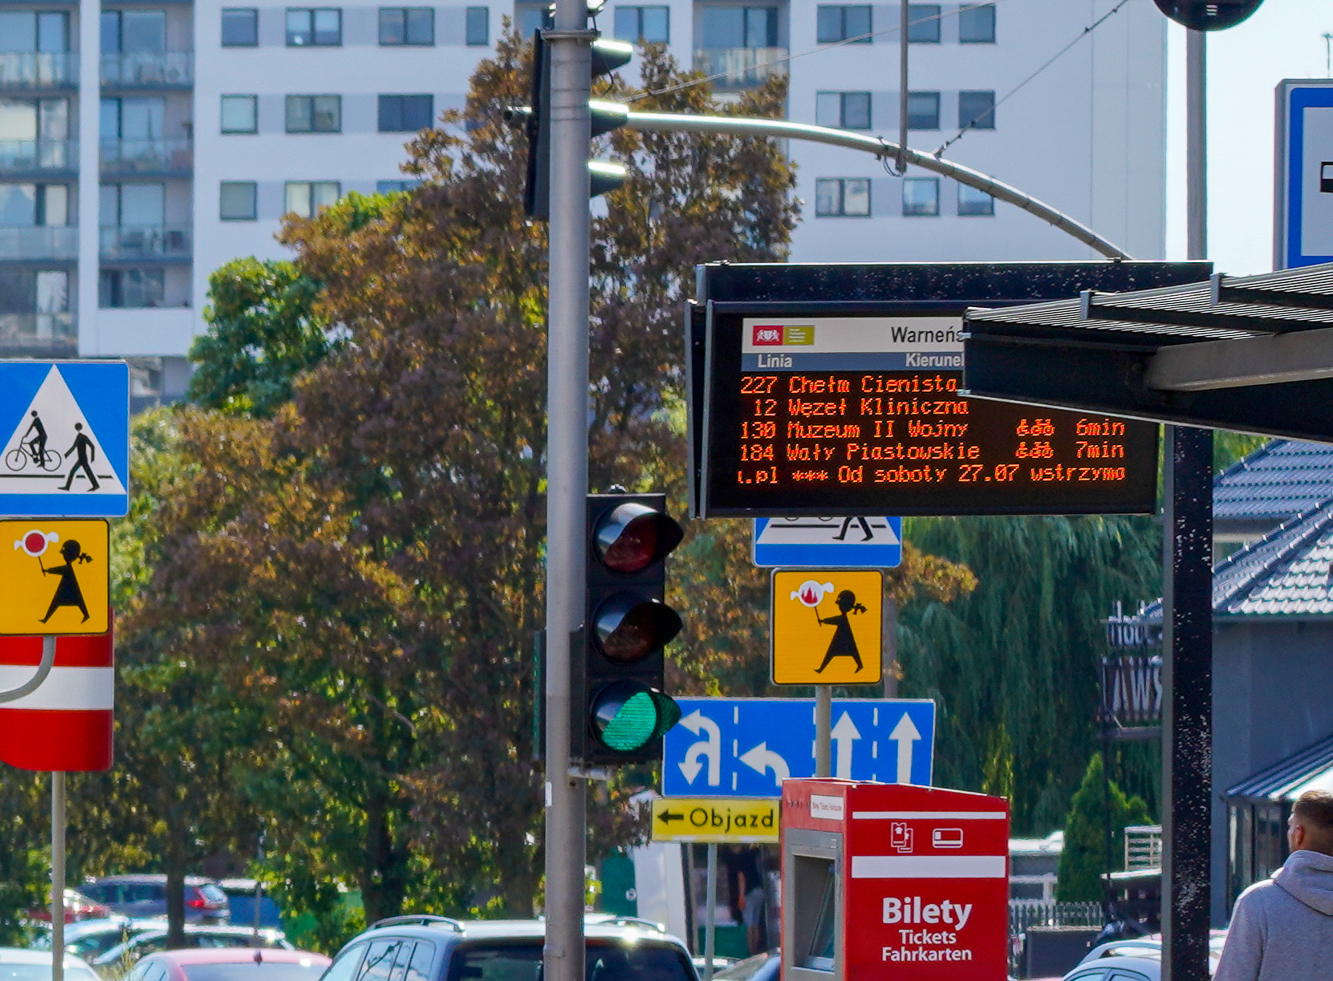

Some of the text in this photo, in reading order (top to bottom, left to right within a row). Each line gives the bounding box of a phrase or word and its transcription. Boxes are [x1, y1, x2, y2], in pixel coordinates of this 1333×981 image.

[757, 354, 793, 368] Linia
[741, 375, 959, 394] 227 Chełm Cienista
[754, 398, 969, 418] 12 Węzeł Kliniczna
[741, 418, 1125, 439] 130 Muzeum II Wojny 6min
[741, 441, 1124, 461] 184 Wały Piastowskie 7min
[838, 465, 864, 483] Od
[875, 464, 947, 482] soboty
[958, 464, 1020, 482] 27.07
[690, 807, 774, 834] Objazd
[882, 896, 972, 931] Bilety
[899, 929, 957, 945] Tickets
[882, 946, 973, 961] Fahrkarten
